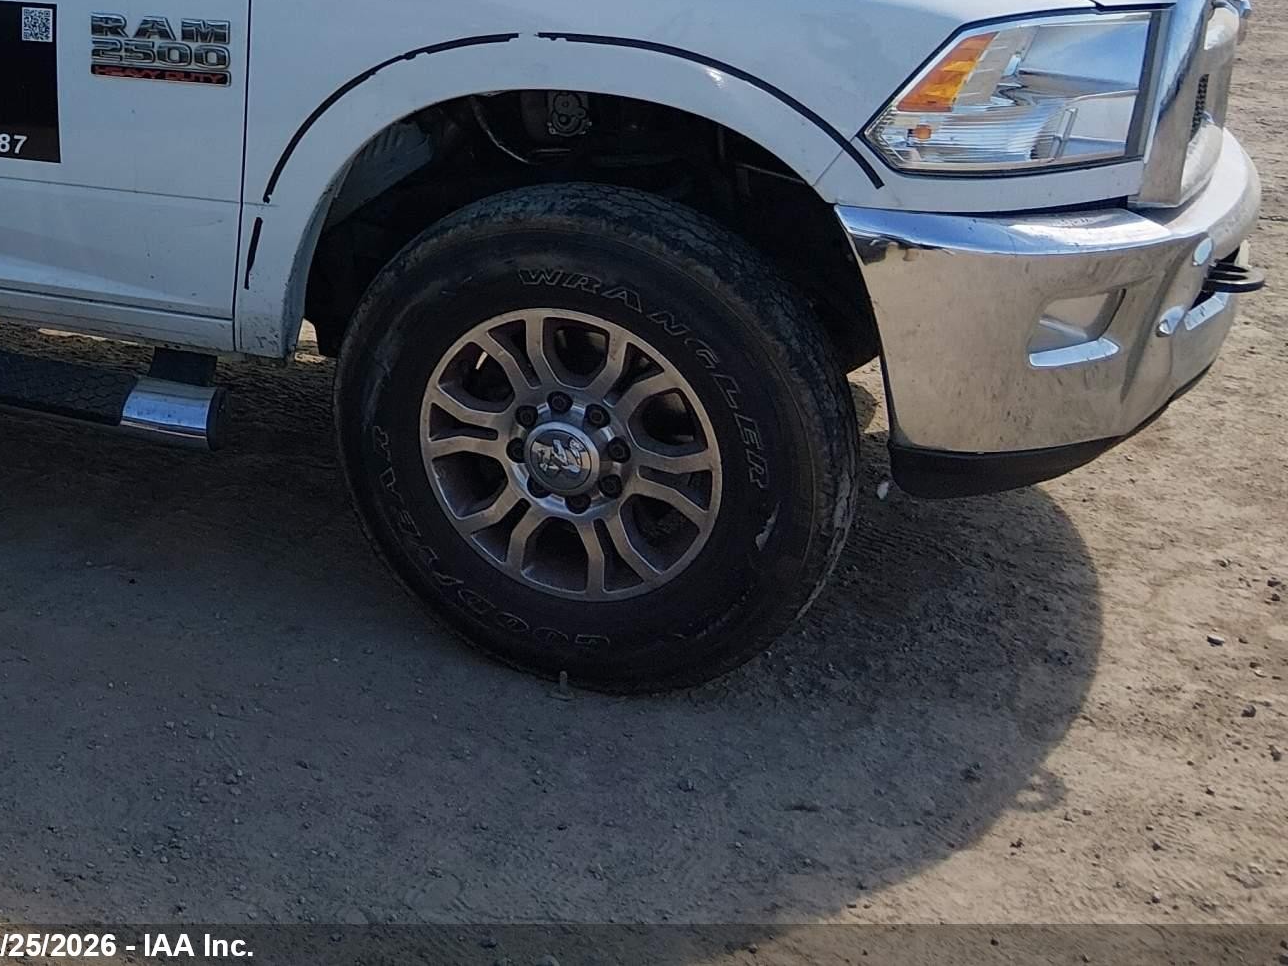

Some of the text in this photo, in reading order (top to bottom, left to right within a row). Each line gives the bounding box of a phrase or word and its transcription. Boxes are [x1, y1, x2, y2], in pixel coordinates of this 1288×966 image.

[91, 12, 230, 44] RAM
[91, 37, 231, 70] 2500
[518, 268, 771, 490] WRANGLER
